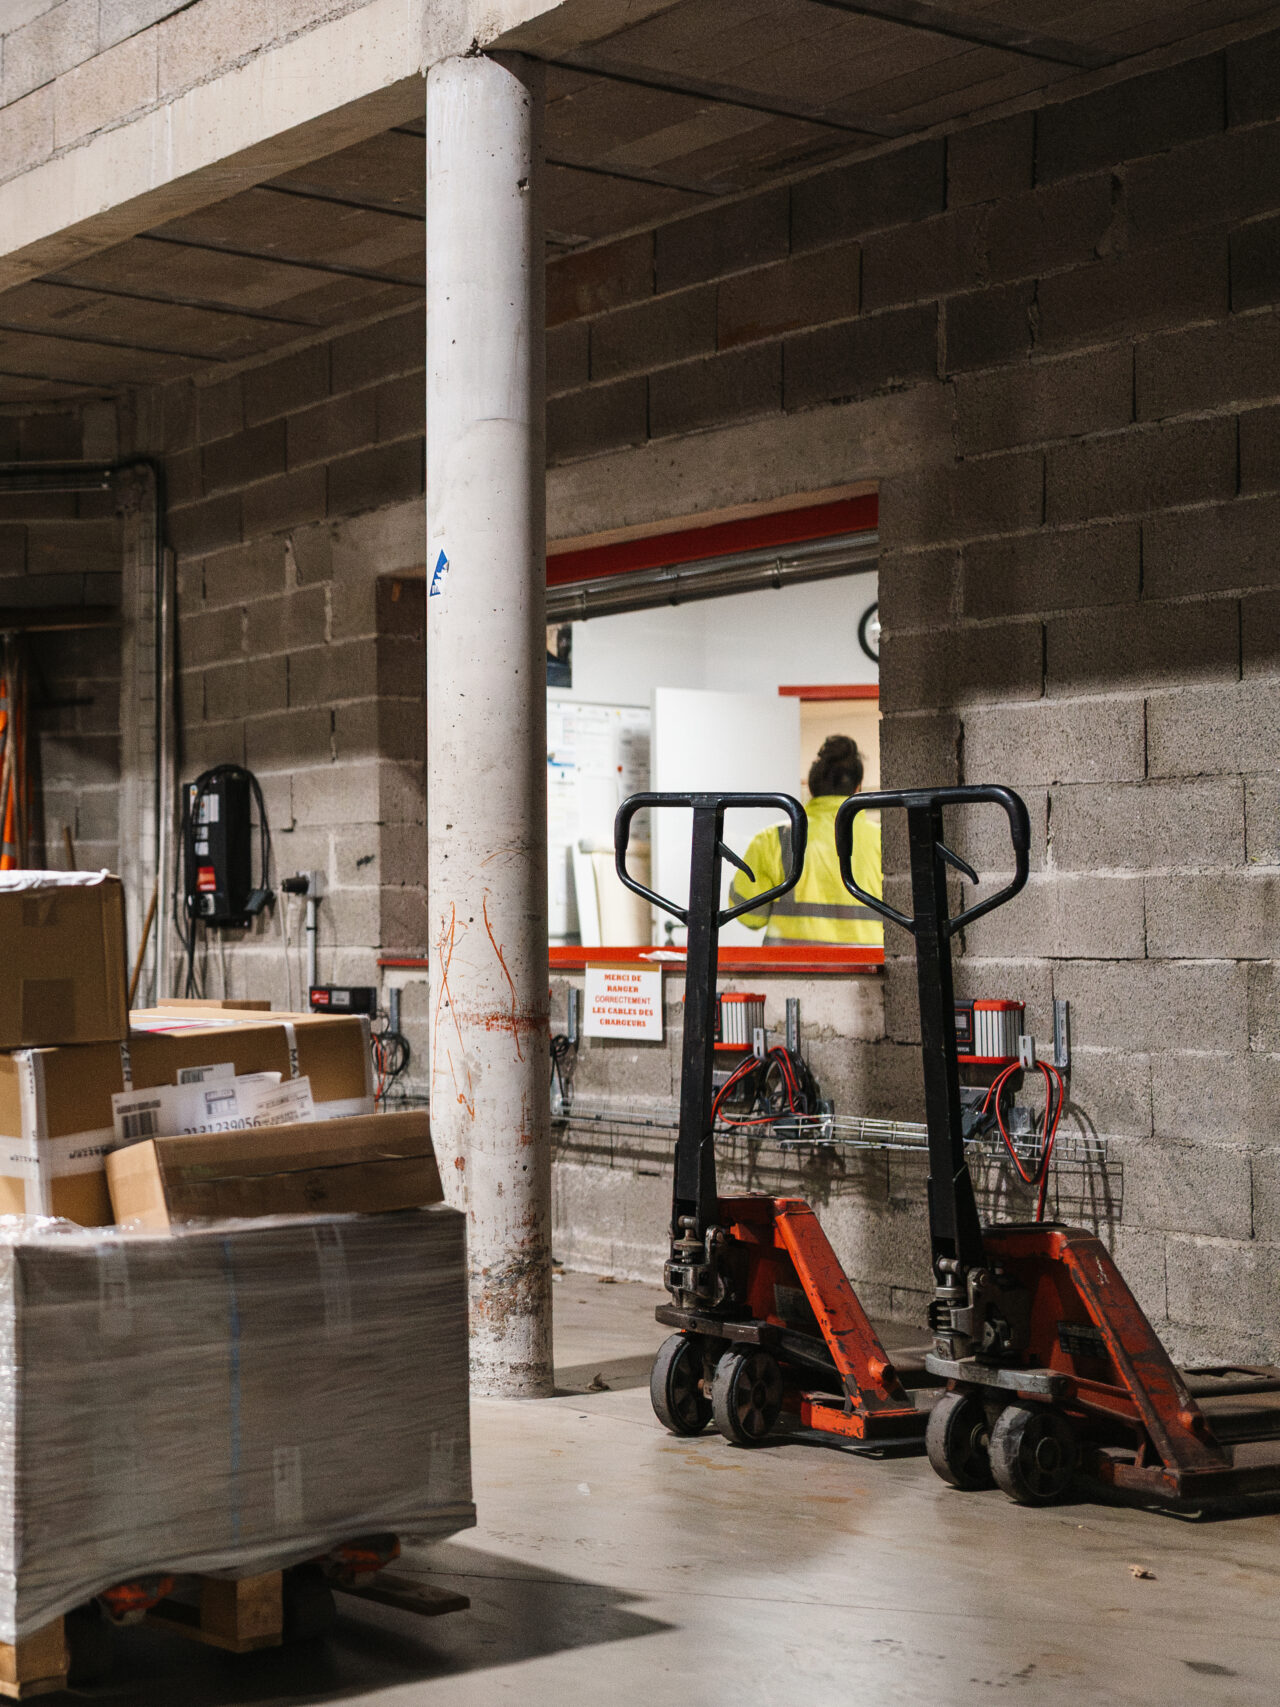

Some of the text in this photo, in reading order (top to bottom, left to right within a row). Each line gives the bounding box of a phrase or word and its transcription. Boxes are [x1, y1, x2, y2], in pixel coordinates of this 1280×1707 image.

[607, 985, 638, 993] RANGER
[595, 996, 651, 1004] CORRECTEMENT
[607, 1007, 637, 1015] CABLES
[638, 1008, 654, 1016] DES
[600, 1018, 646, 1027] CHARGEURS
